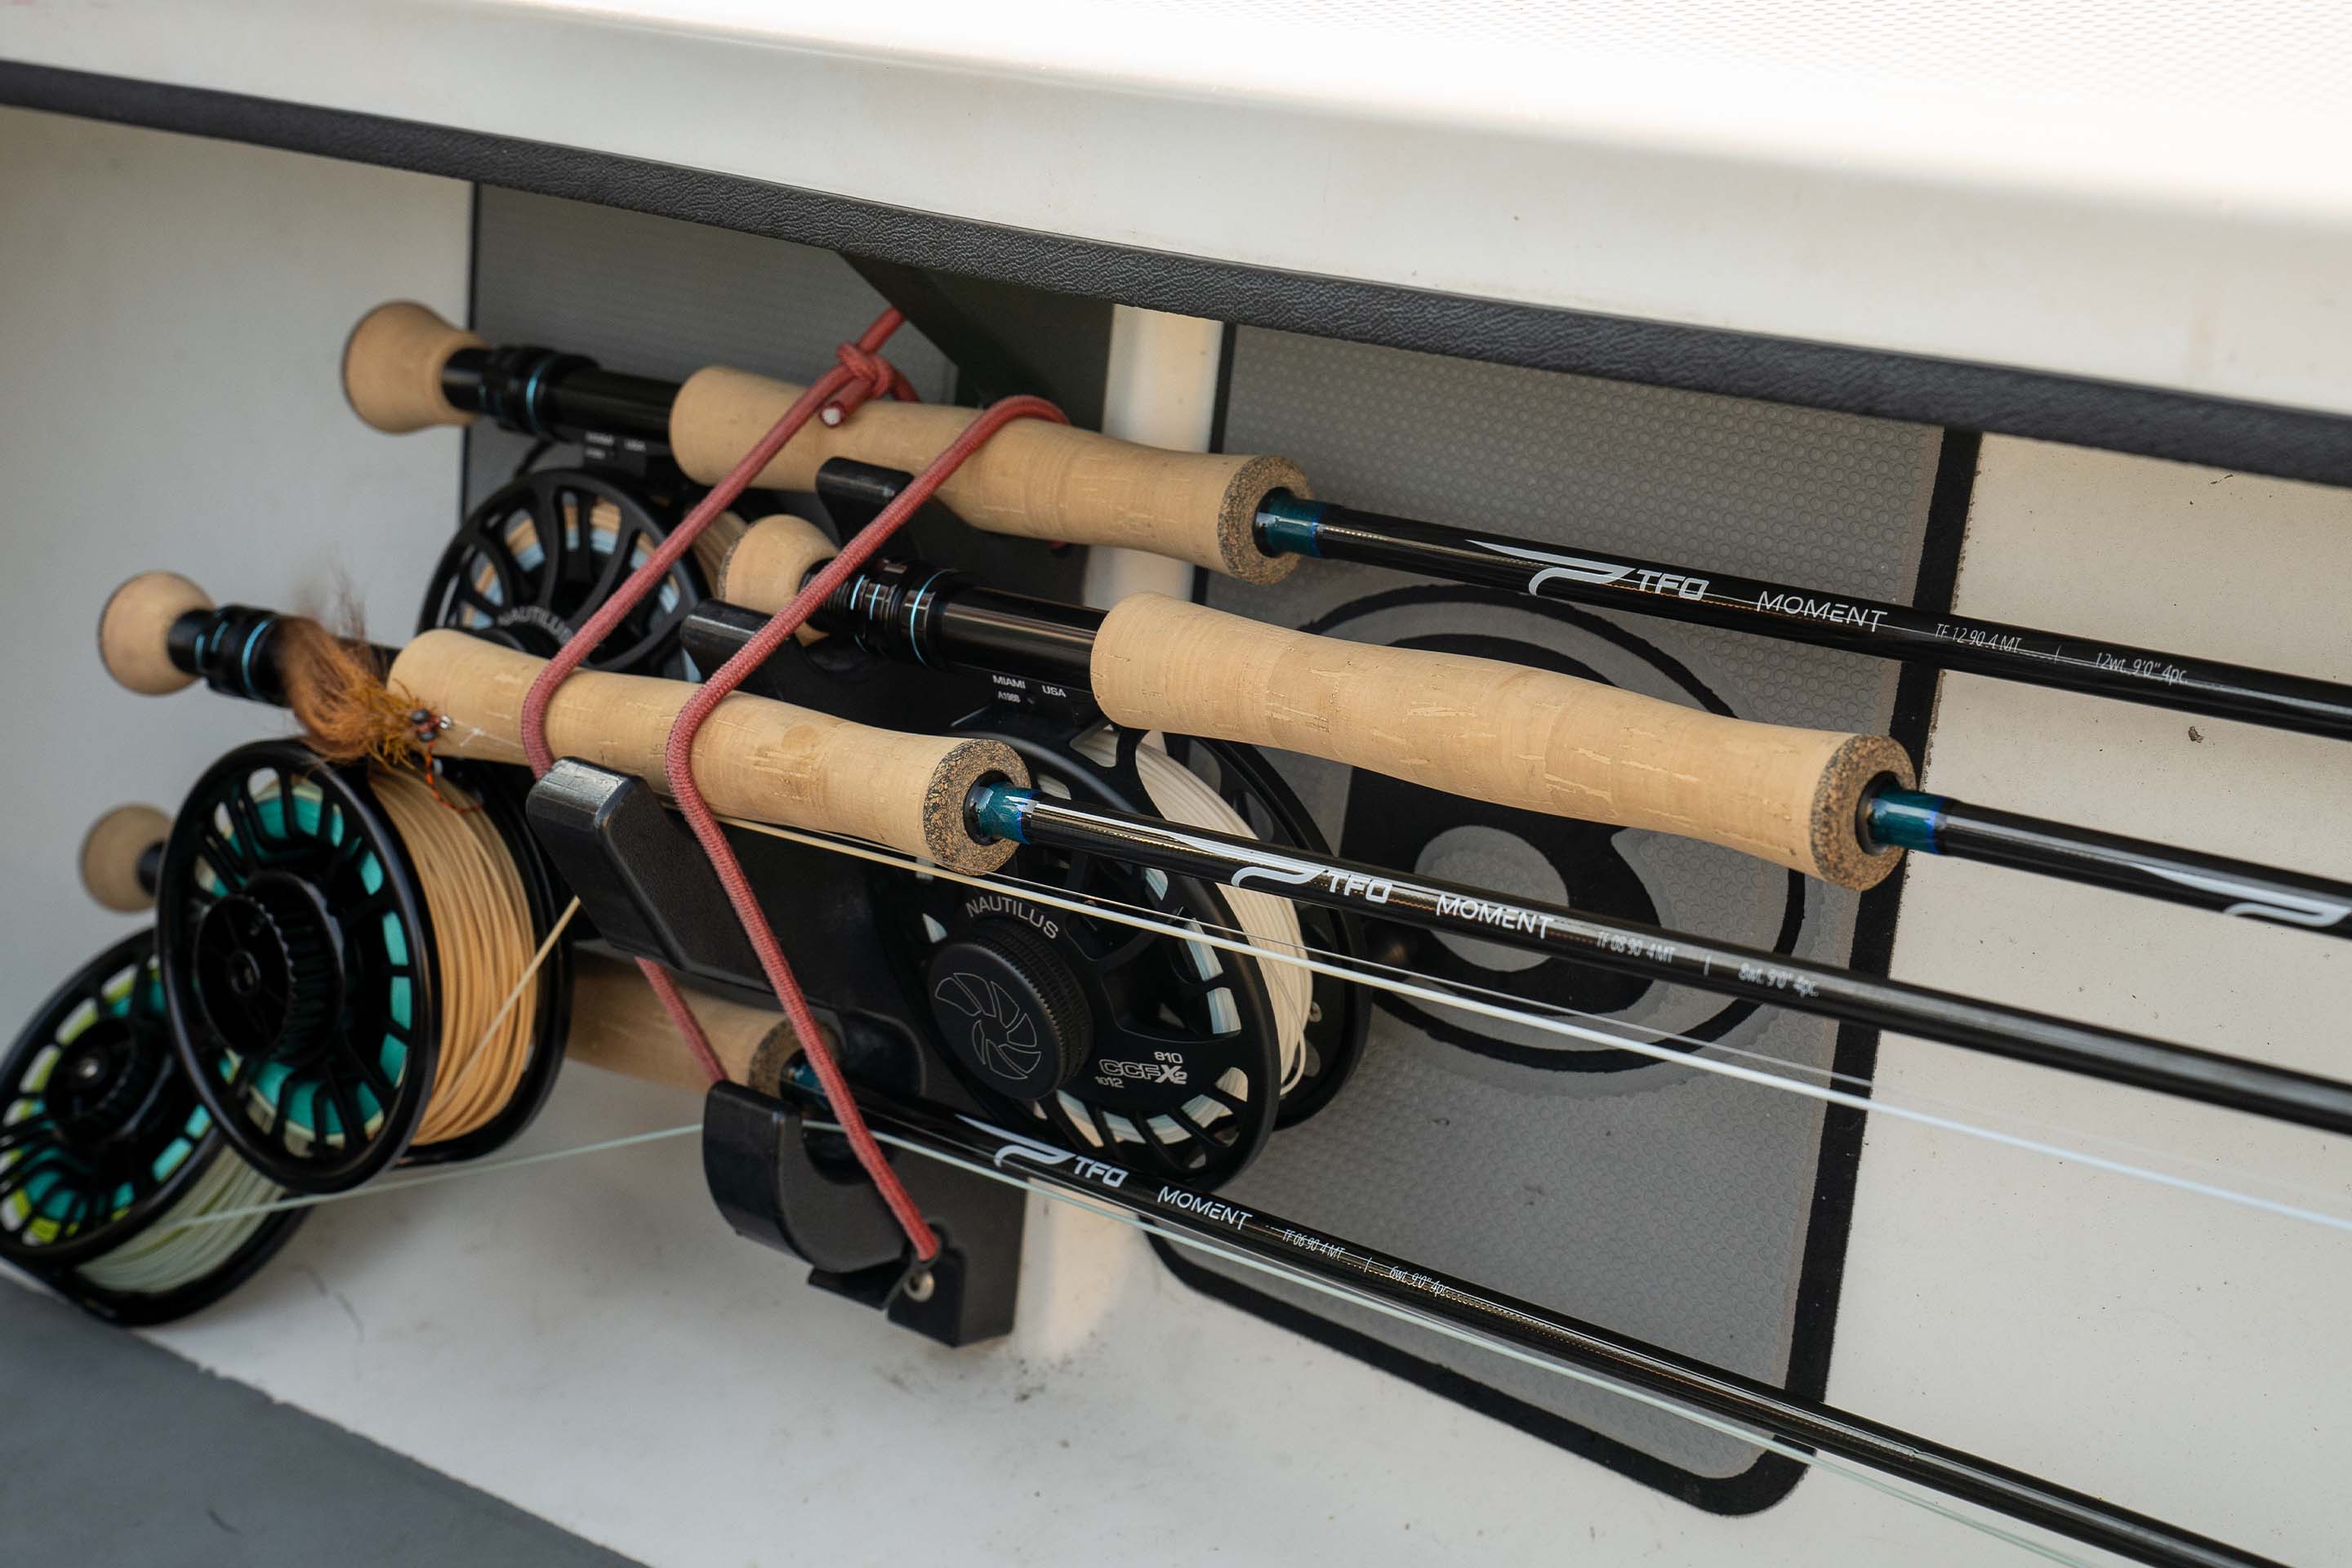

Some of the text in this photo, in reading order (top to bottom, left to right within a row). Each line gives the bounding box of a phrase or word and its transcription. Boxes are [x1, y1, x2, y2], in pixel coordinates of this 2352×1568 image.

[1636, 569, 1709, 601] TFO
[1757, 590, 1888, 633] MOMENT
[1935, 623, 1950, 639] TF
[1953, 626, 1967, 644] 12
[1999, 635, 2023, 653] MT
[992, 675, 1067, 698] MIAMI USA
[966, 895, 1059, 939] NAUTILUS
[1328, 870, 1393, 903] TFO
[1436, 893, 1554, 939] MOMENT
[1154, 1051, 1183, 1064] 810
[1094, 1076, 1125, 1089] 1012
[1074, 1156, 1129, 1187] TFO
[1156, 1186, 1254, 1231] MOMENT
[1282, 1228, 1295, 1242] TF
[1293, 1233, 1307, 1247] 06
[1305, 1237, 1320, 1251] 90
[1320, 1242, 1329, 1254] 4
[1327, 1245, 1346, 1259] MT
